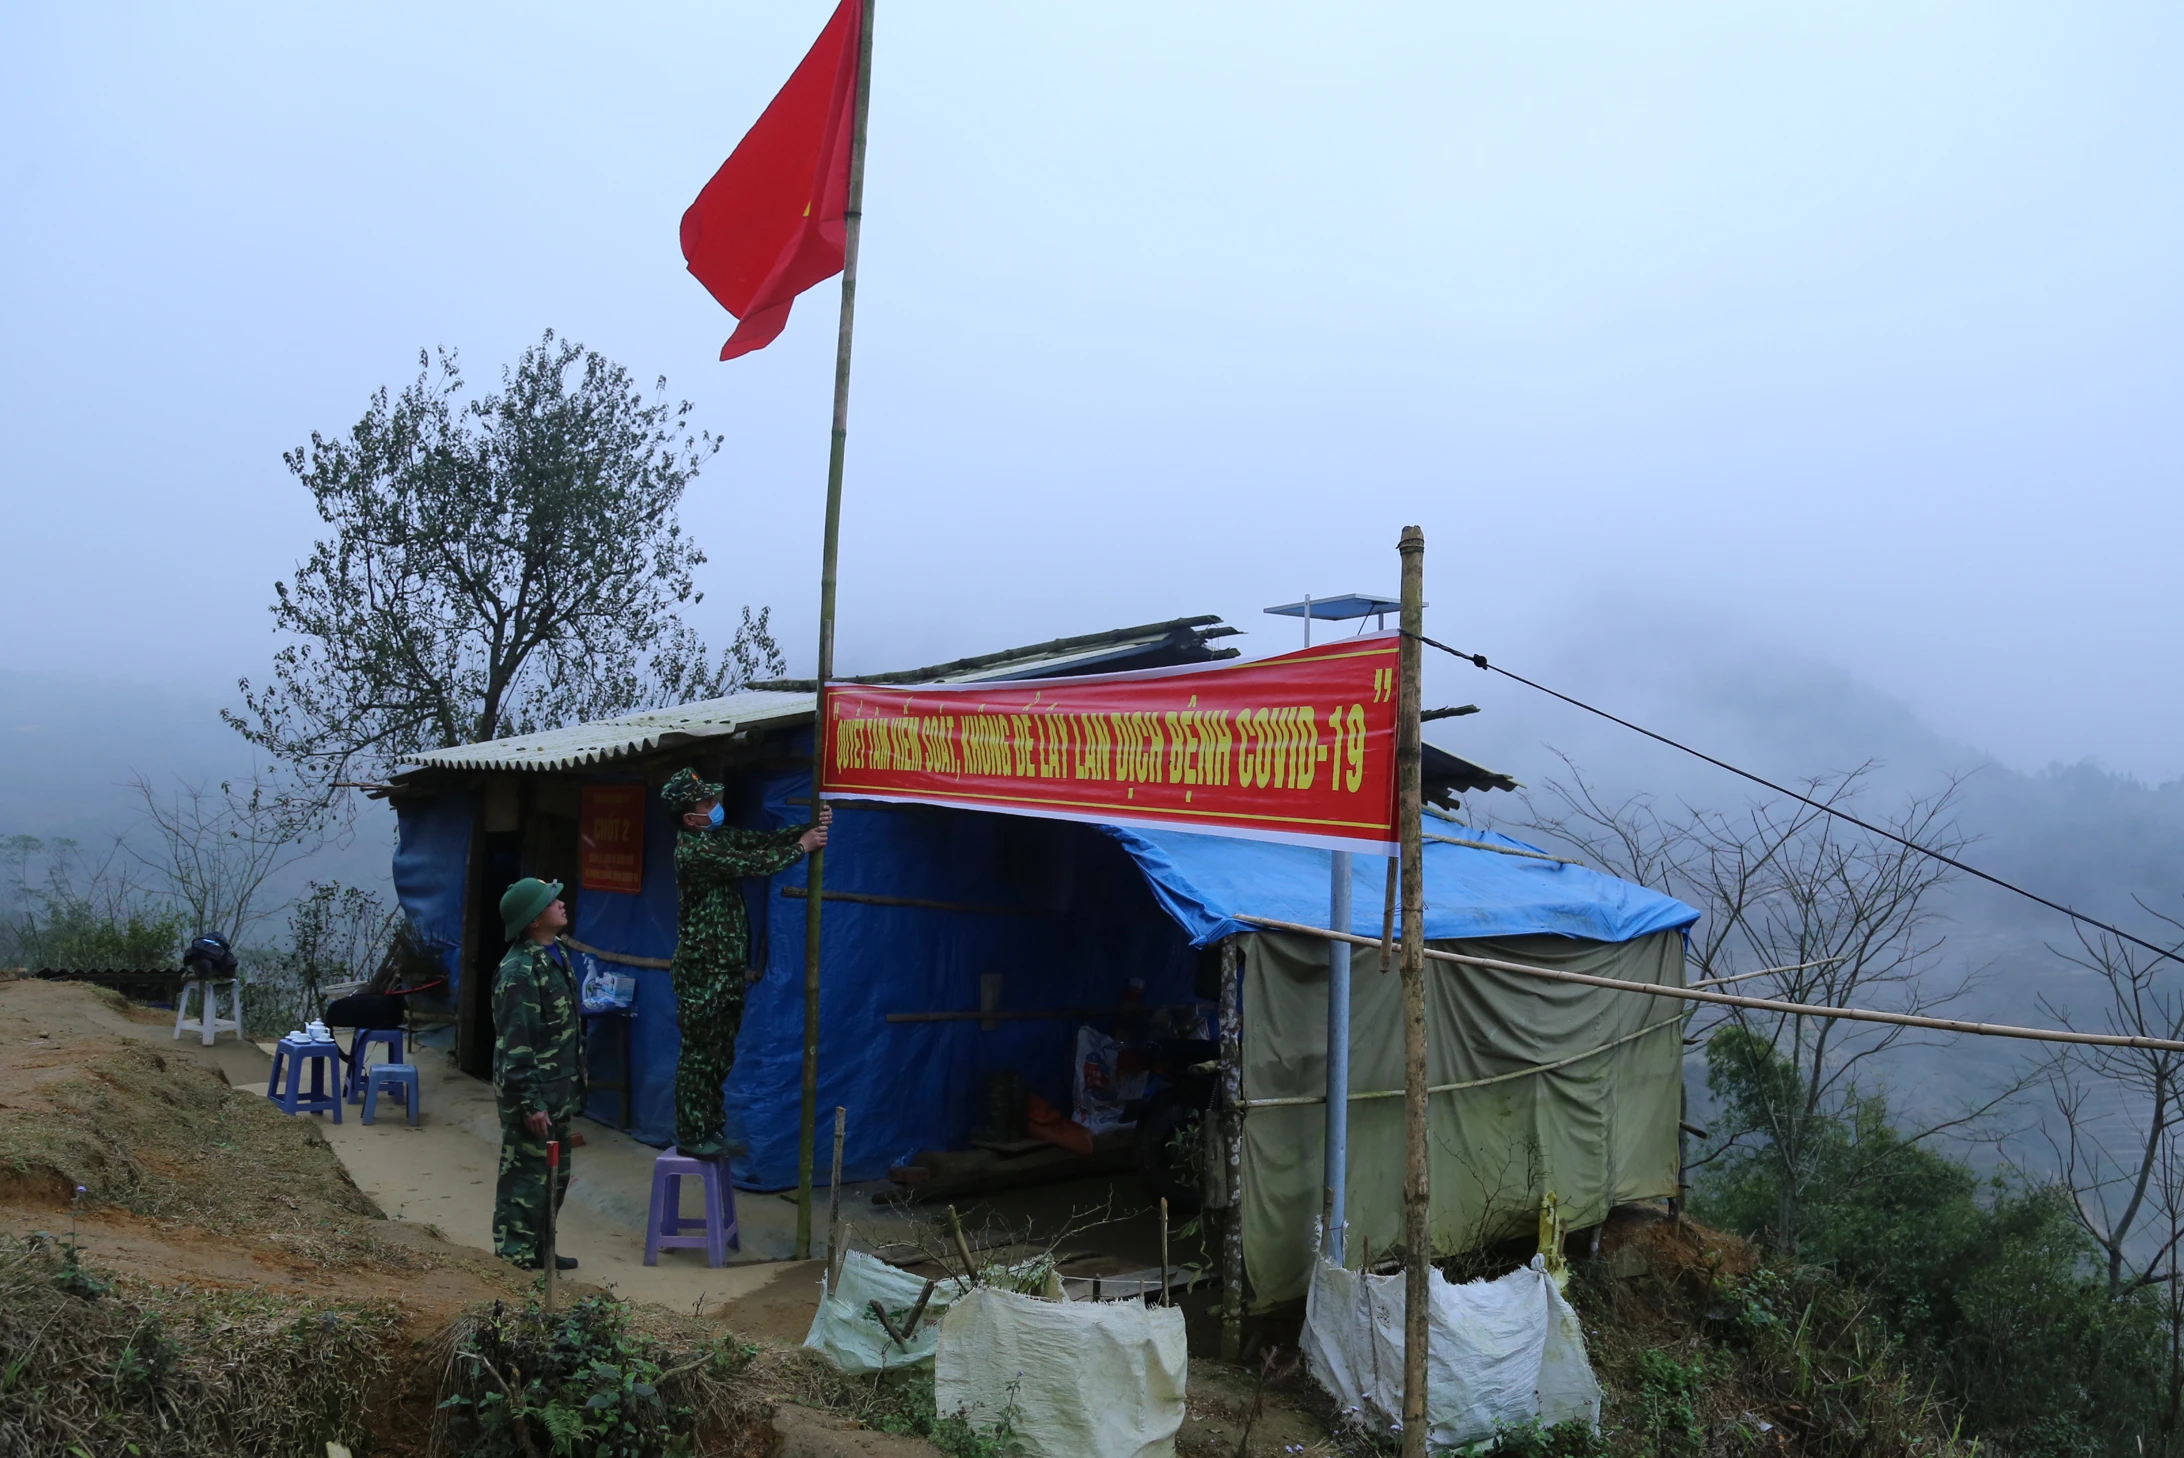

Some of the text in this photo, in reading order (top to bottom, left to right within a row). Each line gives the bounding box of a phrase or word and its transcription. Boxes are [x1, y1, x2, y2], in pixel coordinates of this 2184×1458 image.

[867, 706, 891, 770] TÂM
[922, 703, 961, 782] SOÁT,
[960, 703, 1012, 777] KHÔNG
[1010, 691, 1041, 778] ĐỂ
[1034, 702, 1069, 779] LÂY
[1069, 712, 1111, 781] LAN
[1110, 711, 1165, 799] DỊCH
[1164, 694, 1233, 803] BỆNH
[621, 818, 630, 842] 2
